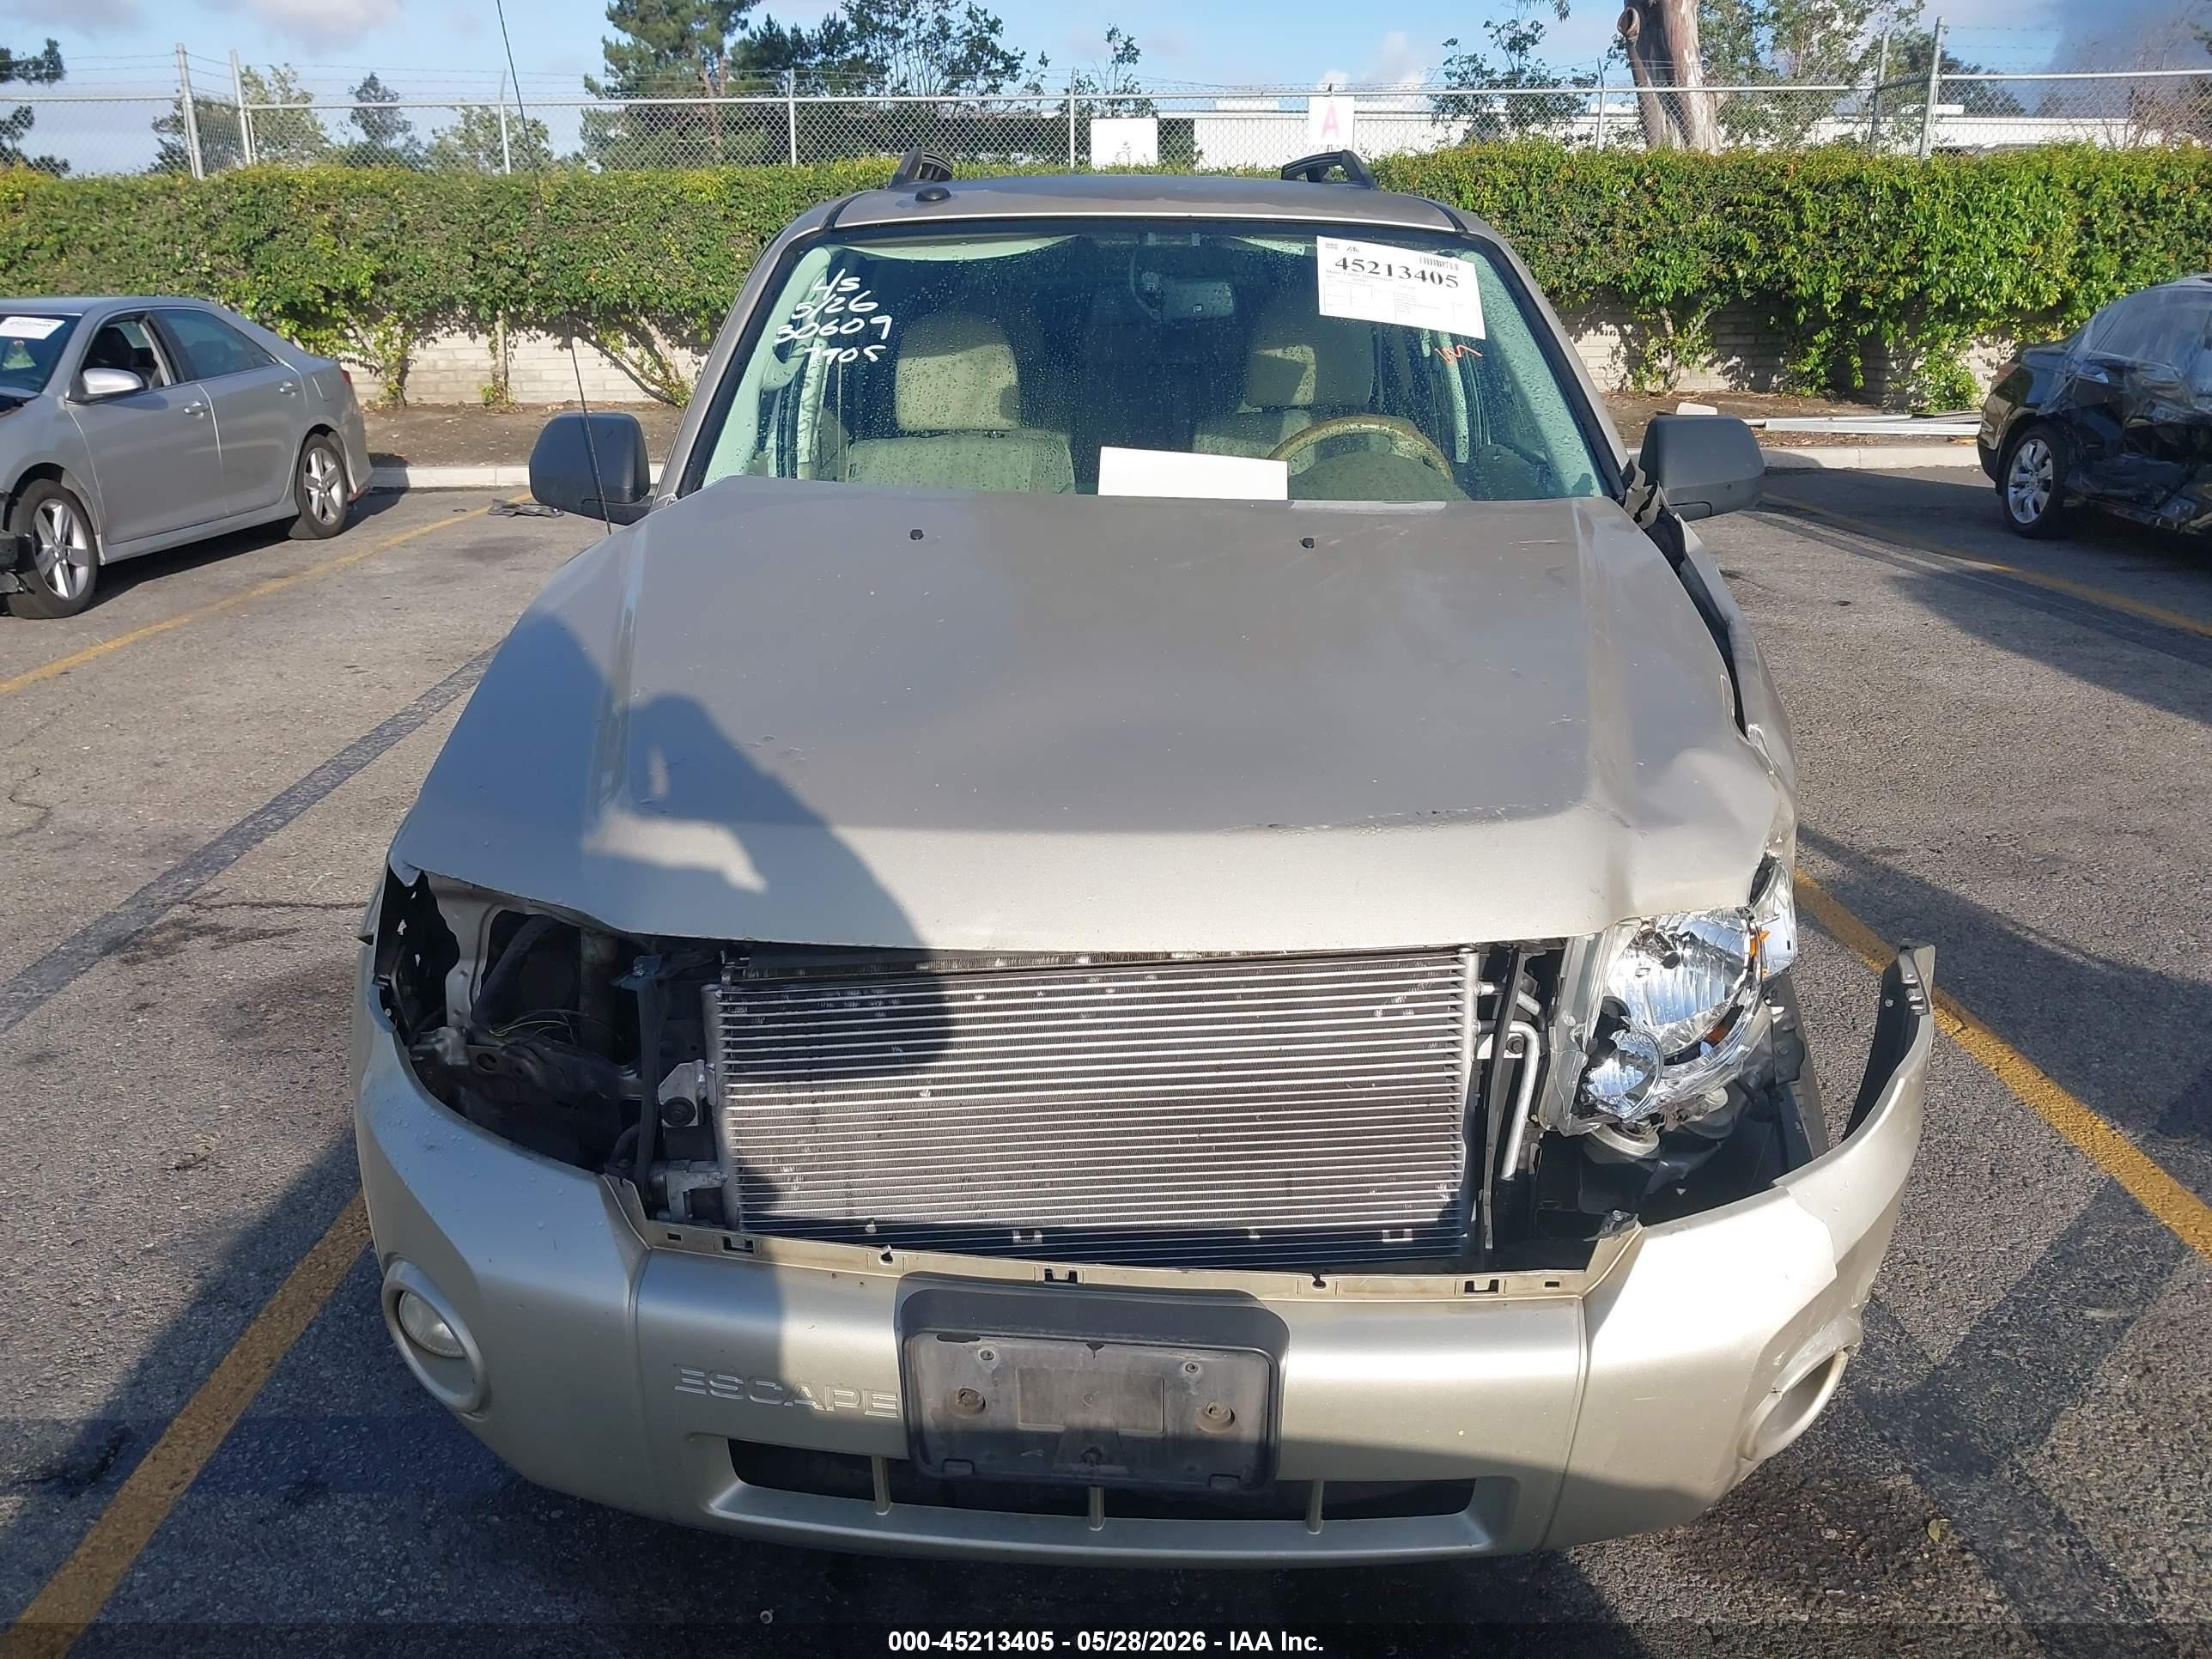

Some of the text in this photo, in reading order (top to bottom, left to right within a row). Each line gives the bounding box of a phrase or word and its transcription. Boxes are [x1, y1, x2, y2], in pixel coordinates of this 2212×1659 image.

[1321, 102, 1340, 138] A
[1335, 257, 1459, 289] 45213405
[673, 1367, 900, 1419] ESCAPE
